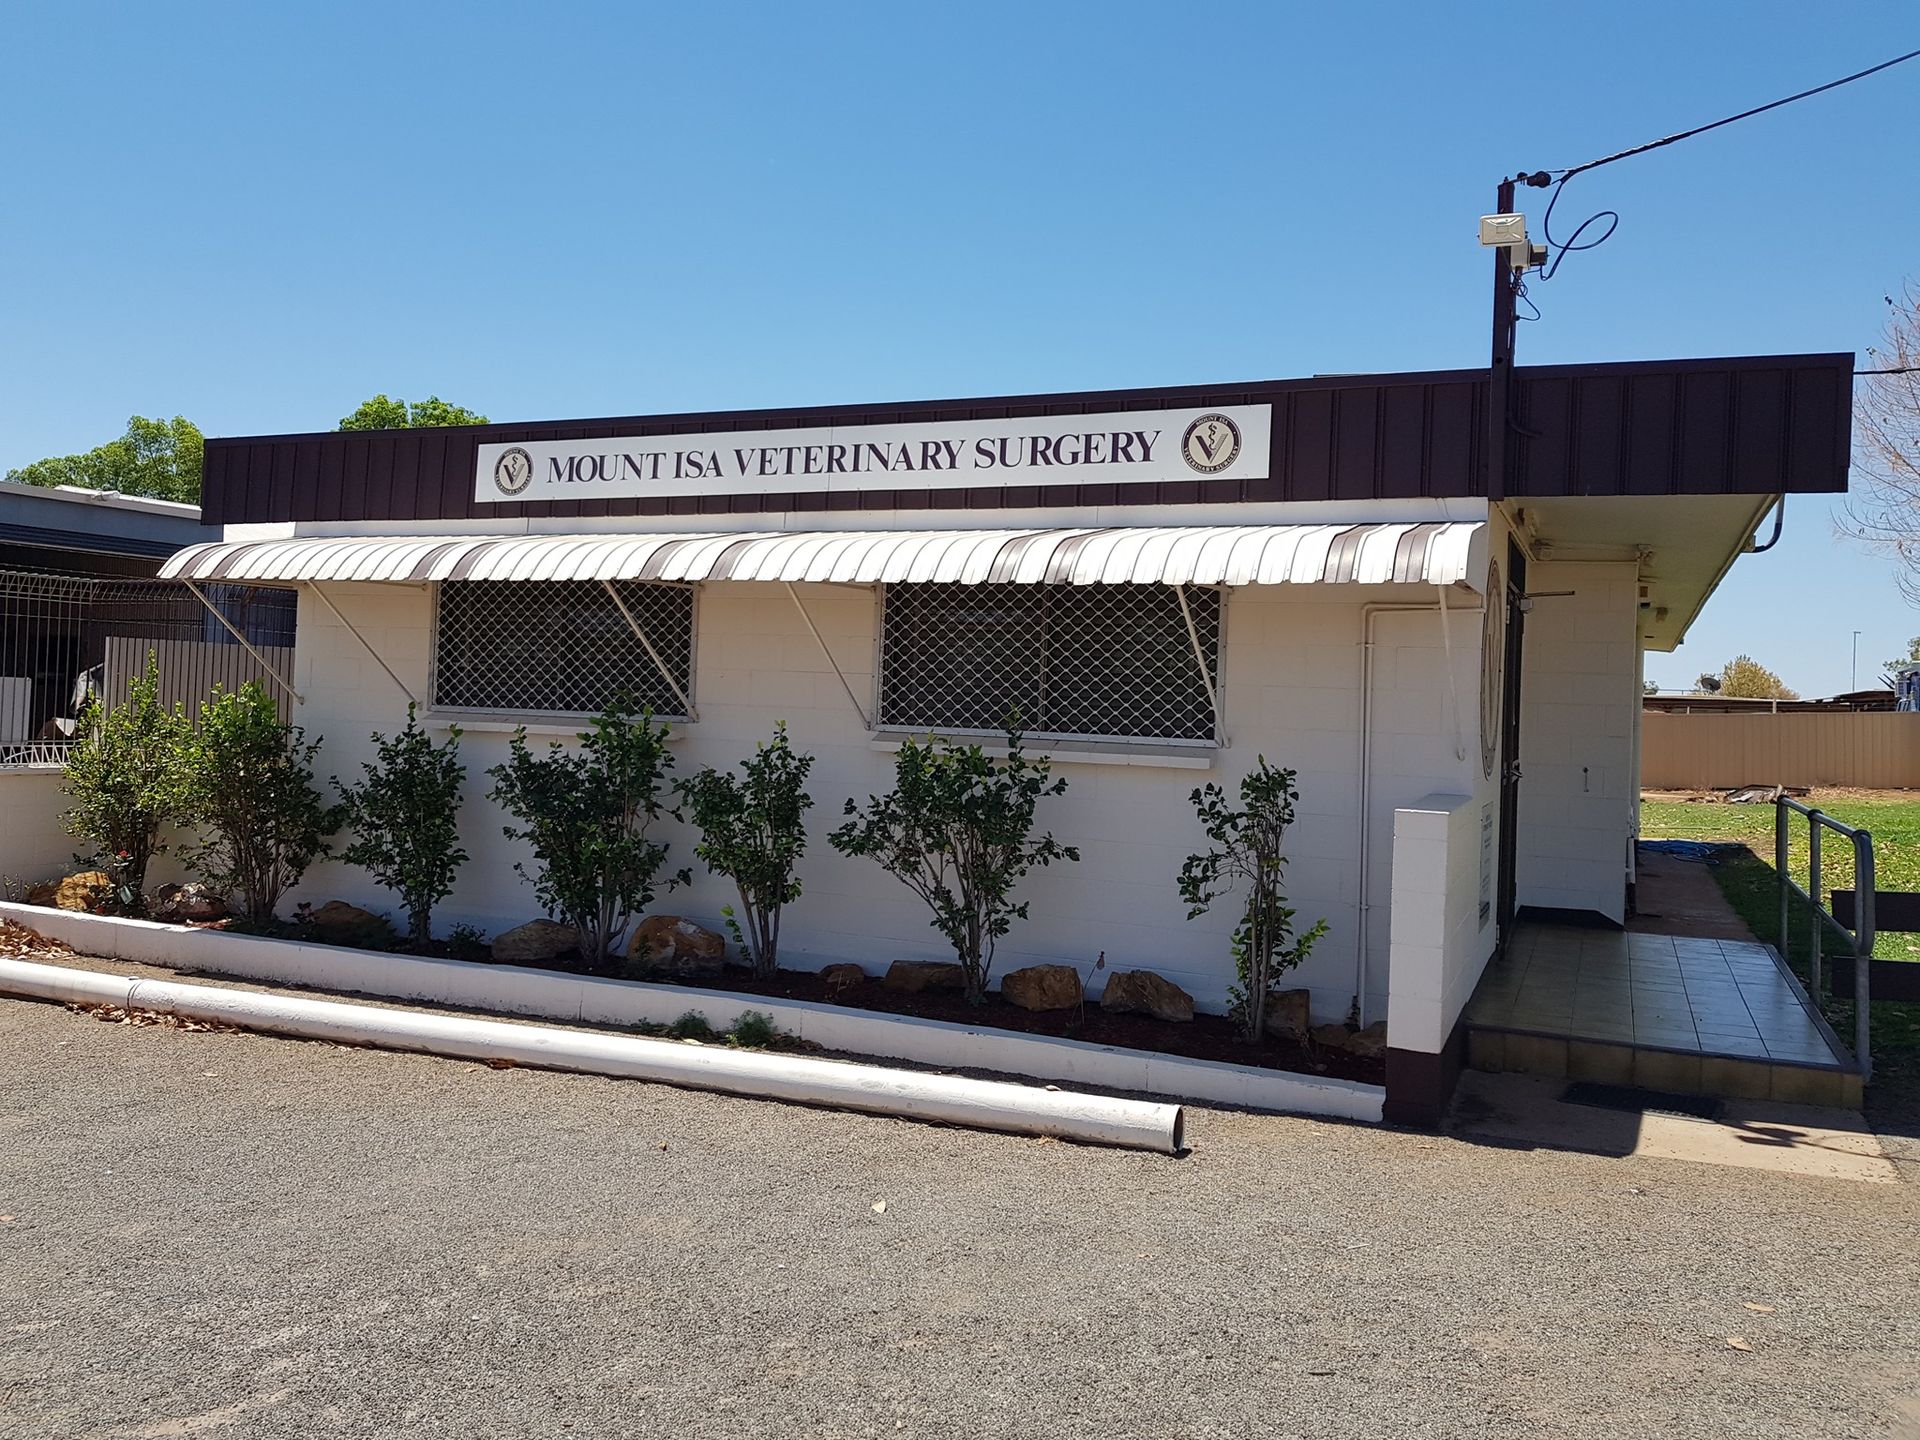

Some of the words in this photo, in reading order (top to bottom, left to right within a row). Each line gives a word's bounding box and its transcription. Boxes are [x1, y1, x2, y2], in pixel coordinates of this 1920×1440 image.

[546, 452, 667, 484] MOUNT
[673, 450, 724, 479] ISA
[733, 439, 967, 477] VETERINARY
[974, 429, 1162, 469] SURGERY
